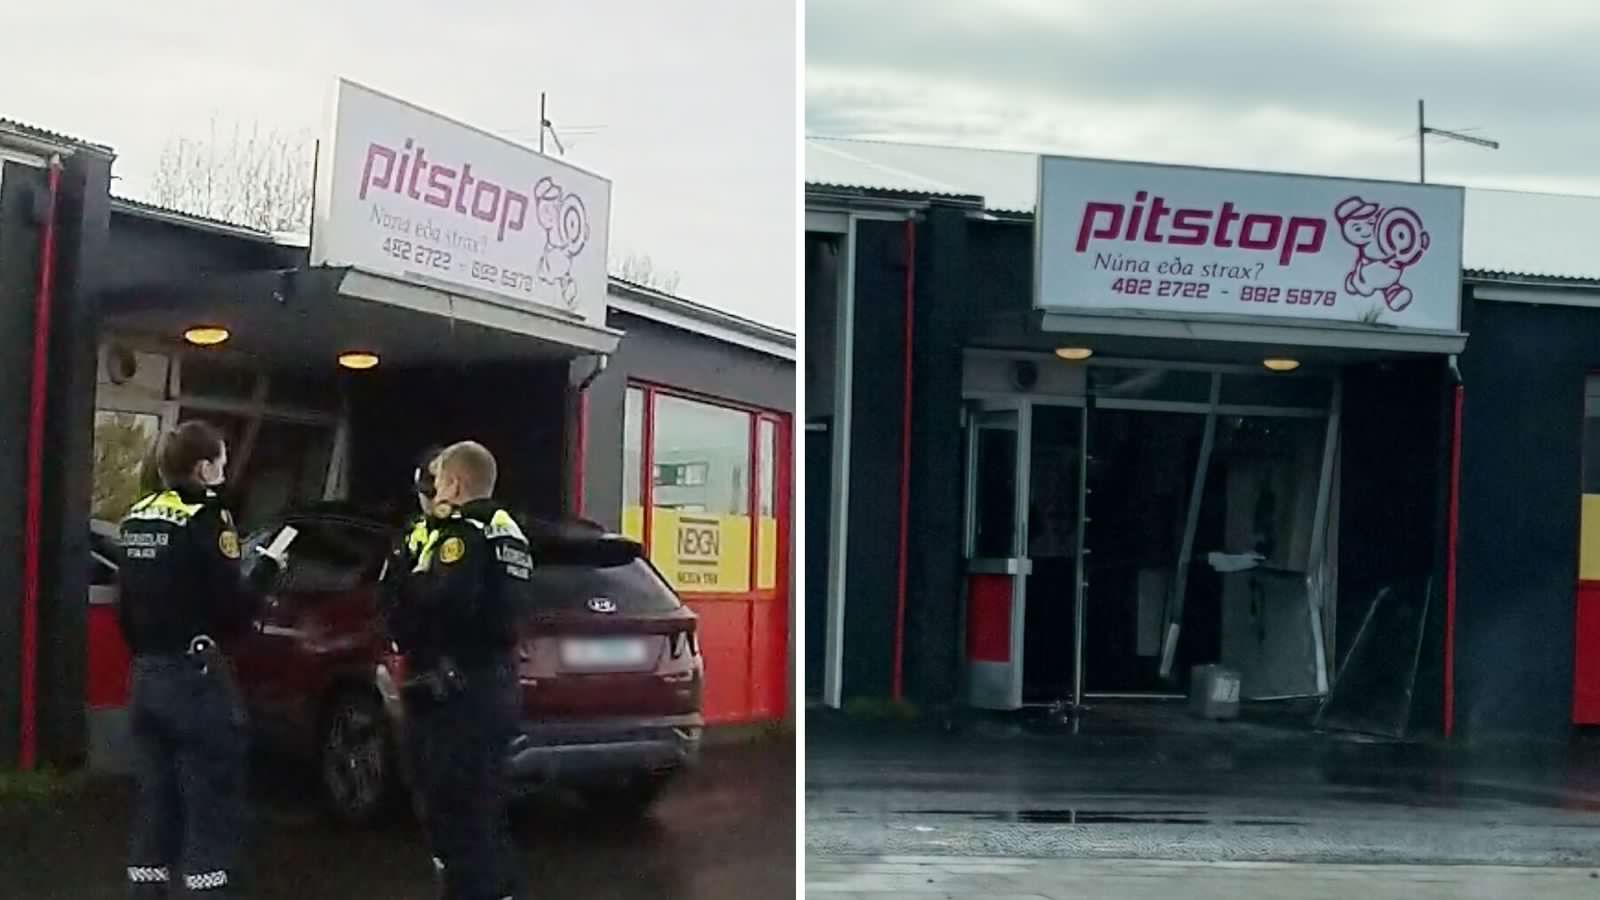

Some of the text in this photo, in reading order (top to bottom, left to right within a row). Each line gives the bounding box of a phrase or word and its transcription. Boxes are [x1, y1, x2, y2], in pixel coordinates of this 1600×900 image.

[359, 138, 529, 241] pitstop
[1075, 190, 1327, 266] pitstop
[1093, 252, 1265, 281] Núna eða strax?
[1111, 277, 1152, 295] 482
[1157, 280, 1210, 299] 2722
